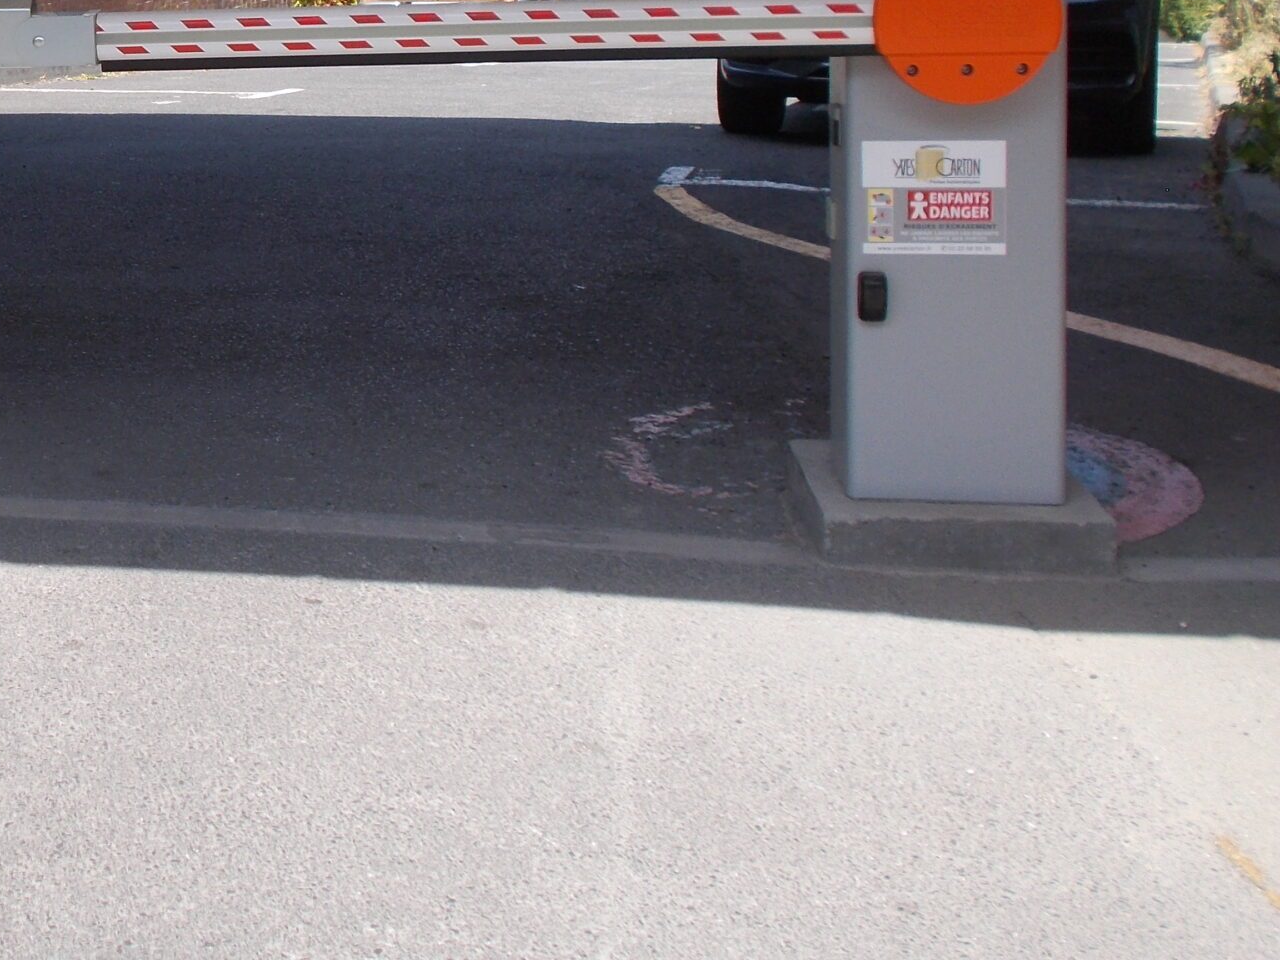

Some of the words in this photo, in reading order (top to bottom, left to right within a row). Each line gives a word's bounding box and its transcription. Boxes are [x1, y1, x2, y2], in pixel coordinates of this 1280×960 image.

[892, 158, 915, 177] YVES
[935, 157, 981, 177] CARTON
[928, 192, 990, 205] ENFANTS
[928, 205, 990, 219] DANGER
